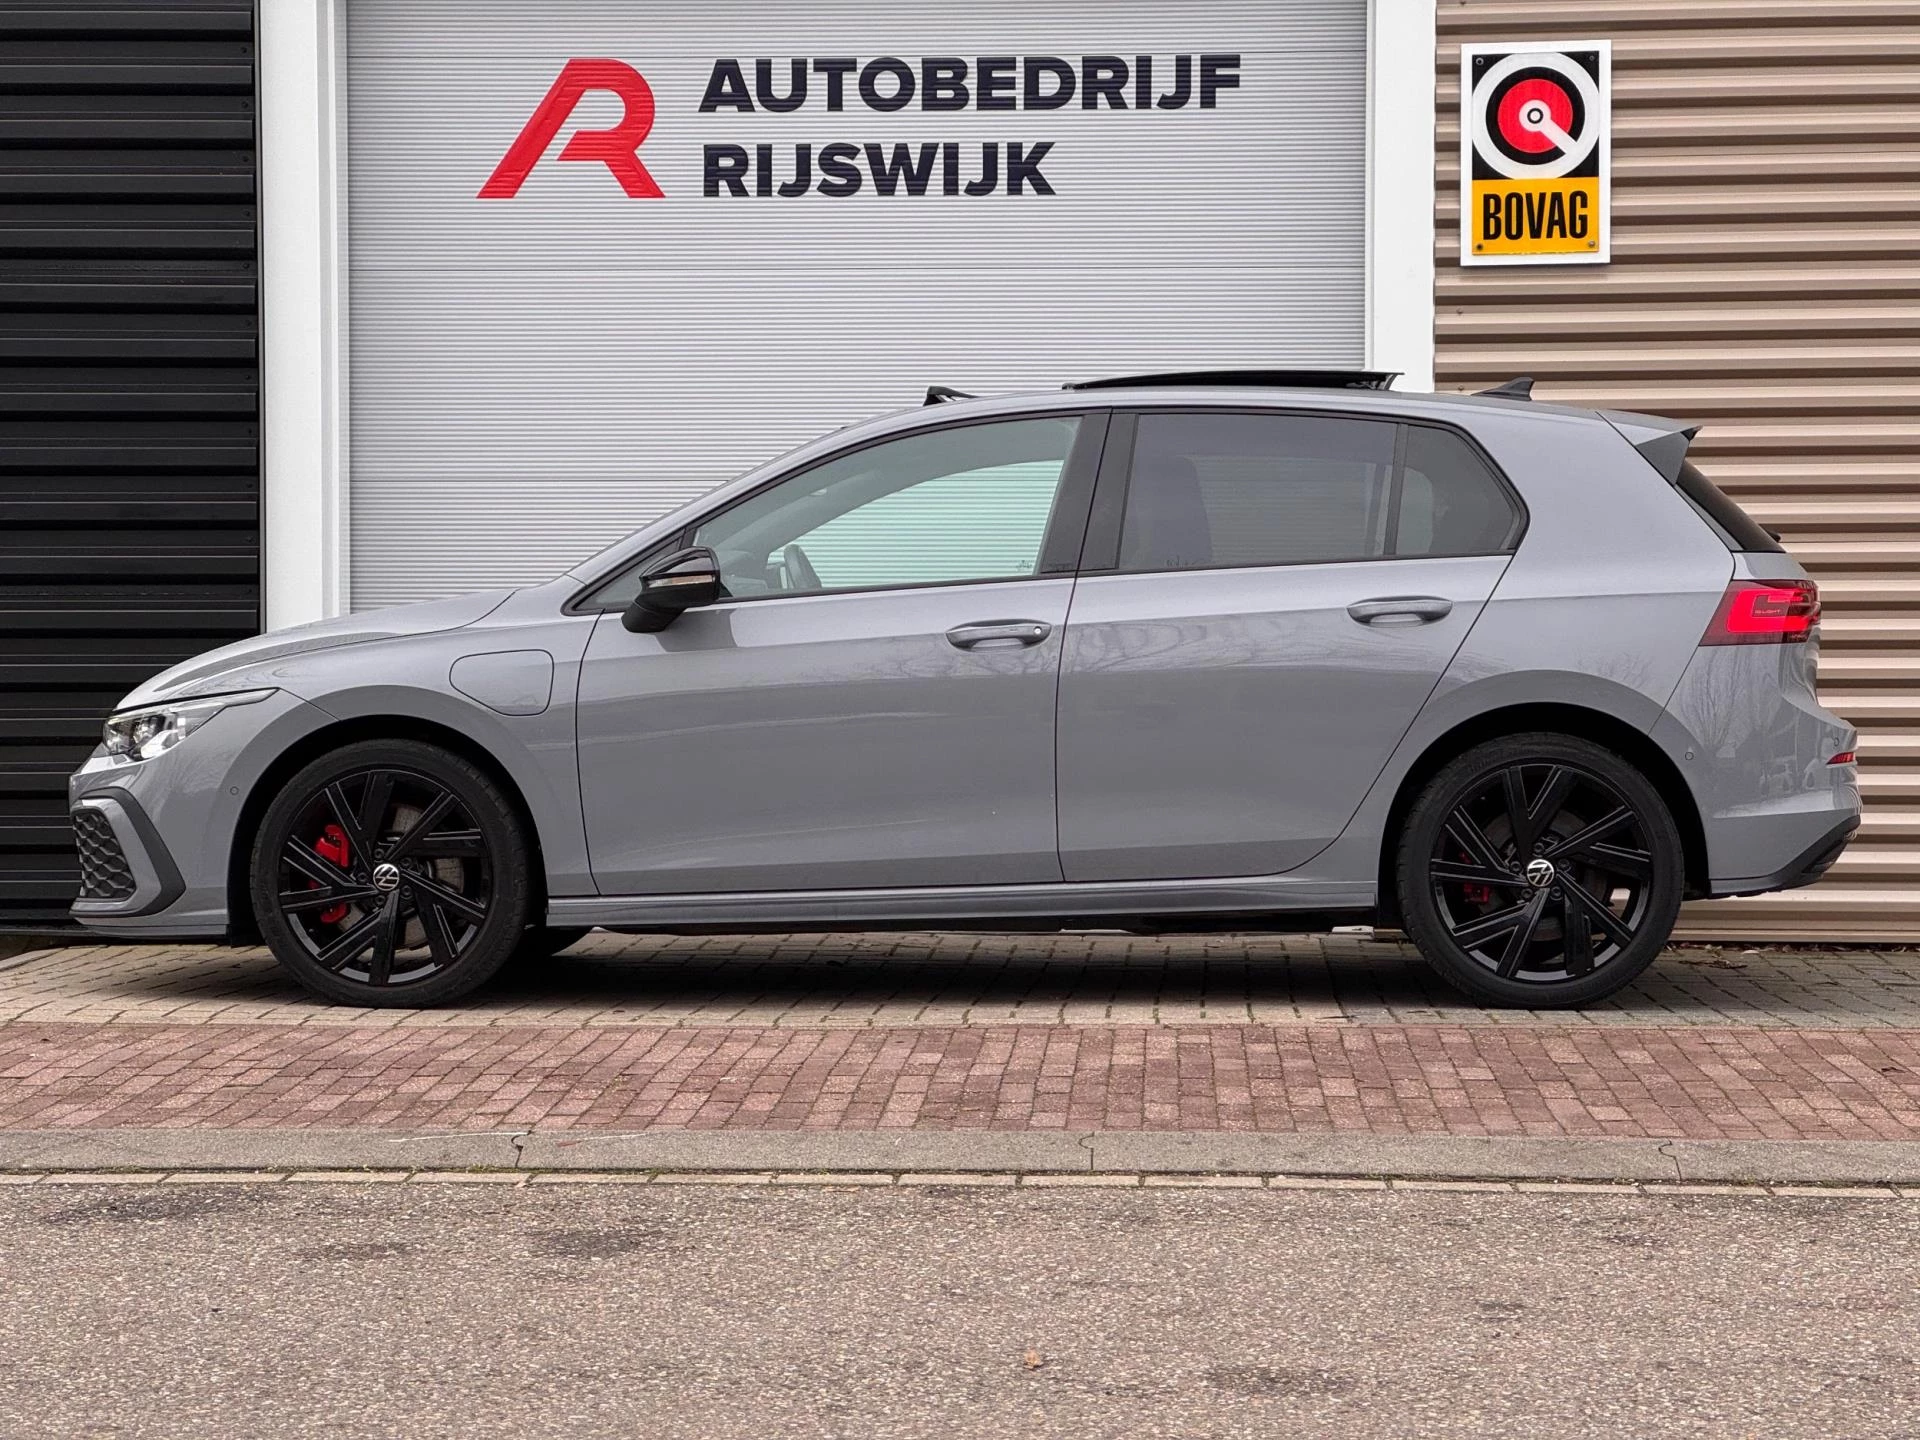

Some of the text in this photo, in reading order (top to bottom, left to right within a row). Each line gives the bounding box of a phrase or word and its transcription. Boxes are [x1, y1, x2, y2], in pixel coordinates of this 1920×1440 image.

[699, 53, 1241, 112] AUTOBEDRIJF
[702, 142, 1055, 197] RIJSWIJK
[1483, 191, 1588, 240] BOVAG
